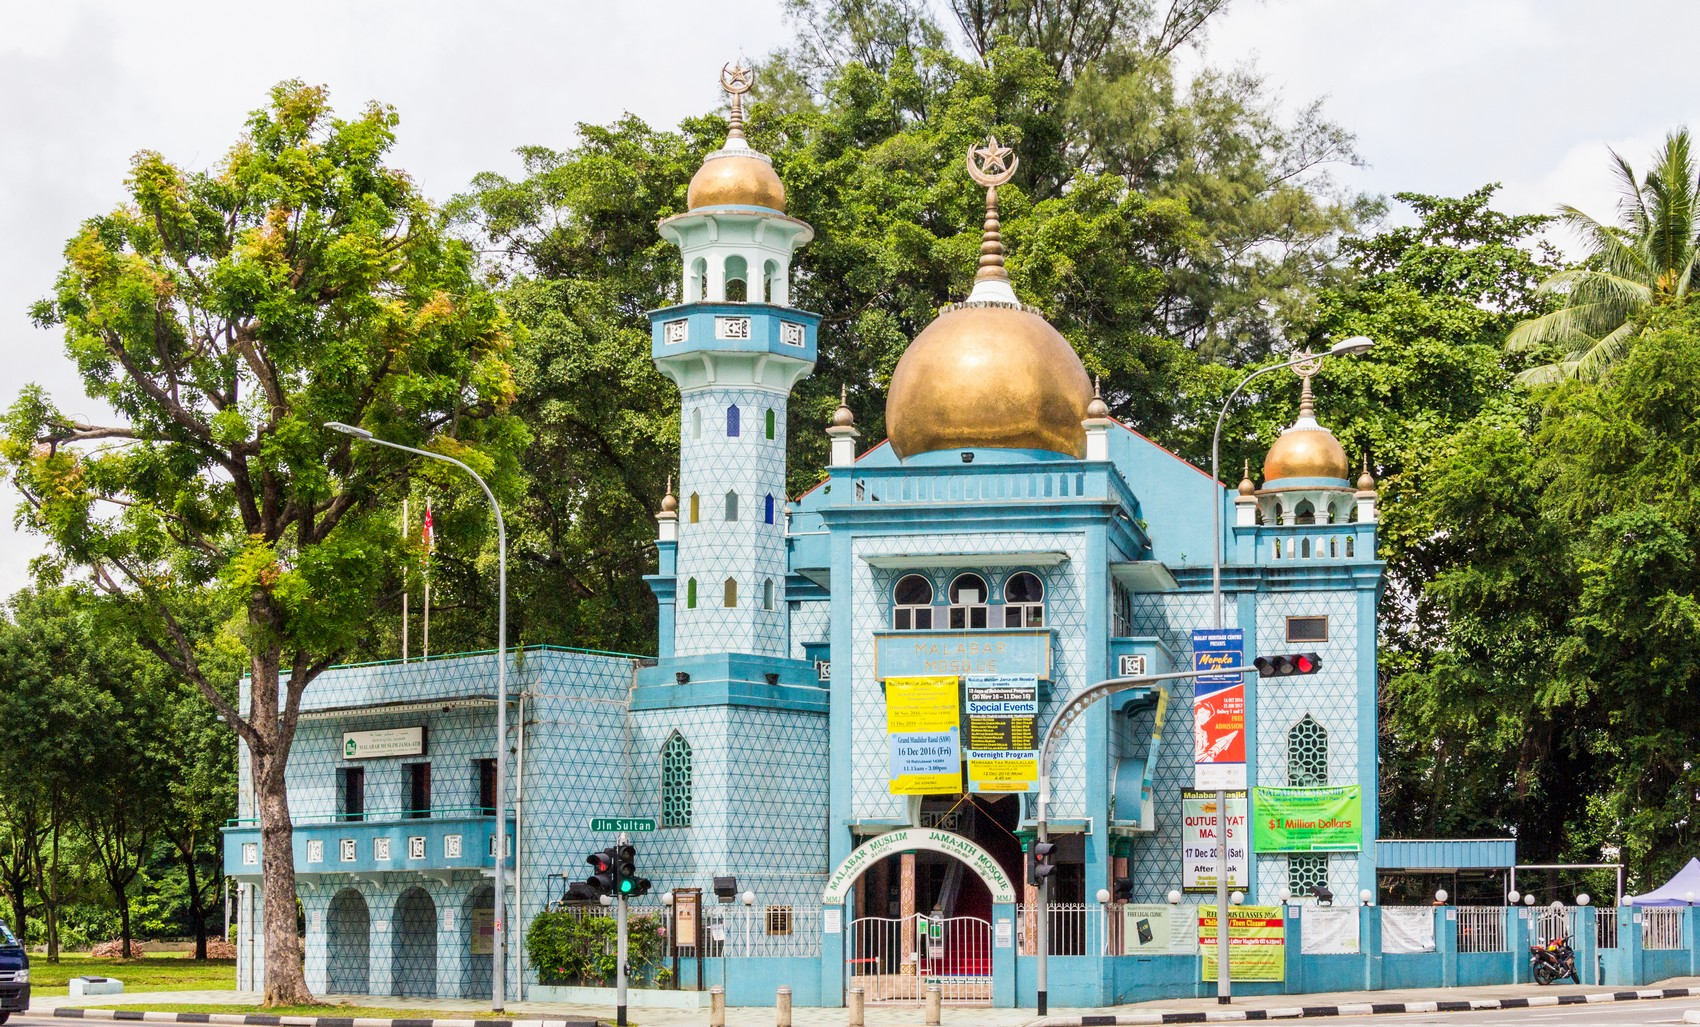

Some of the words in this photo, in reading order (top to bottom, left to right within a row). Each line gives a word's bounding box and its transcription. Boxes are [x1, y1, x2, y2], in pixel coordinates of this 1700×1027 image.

[915, 642, 1006, 656] MALABAR
[924, 659, 998, 673] MOSQUE
[970, 703, 1001, 713] Special
[1004, 702, 1034, 711] Events
[898, 748, 906, 756] 16
[907, 748, 919, 756] Dec
[920, 747, 936, 756] 2016
[938, 746, 952, 756] (Fri)
[597, 820, 612, 830] Jln
[616, 820, 650, 830] Sultan
[1269, 819, 1281, 830] $1
[1285, 819, 1316, 828] Million
[1318, 818, 1352, 828] Dollars
[1186, 849, 1193, 857] 17
[1195, 849, 1208, 857] Dec
[1228, 848, 1244, 859] (Sat)
[830, 849, 868, 892] MALABAR
[869, 831, 908, 851] MUSLIM
[928, 831, 977, 856] JAMA-ATH
[978, 854, 1009, 892] MOSQUE
